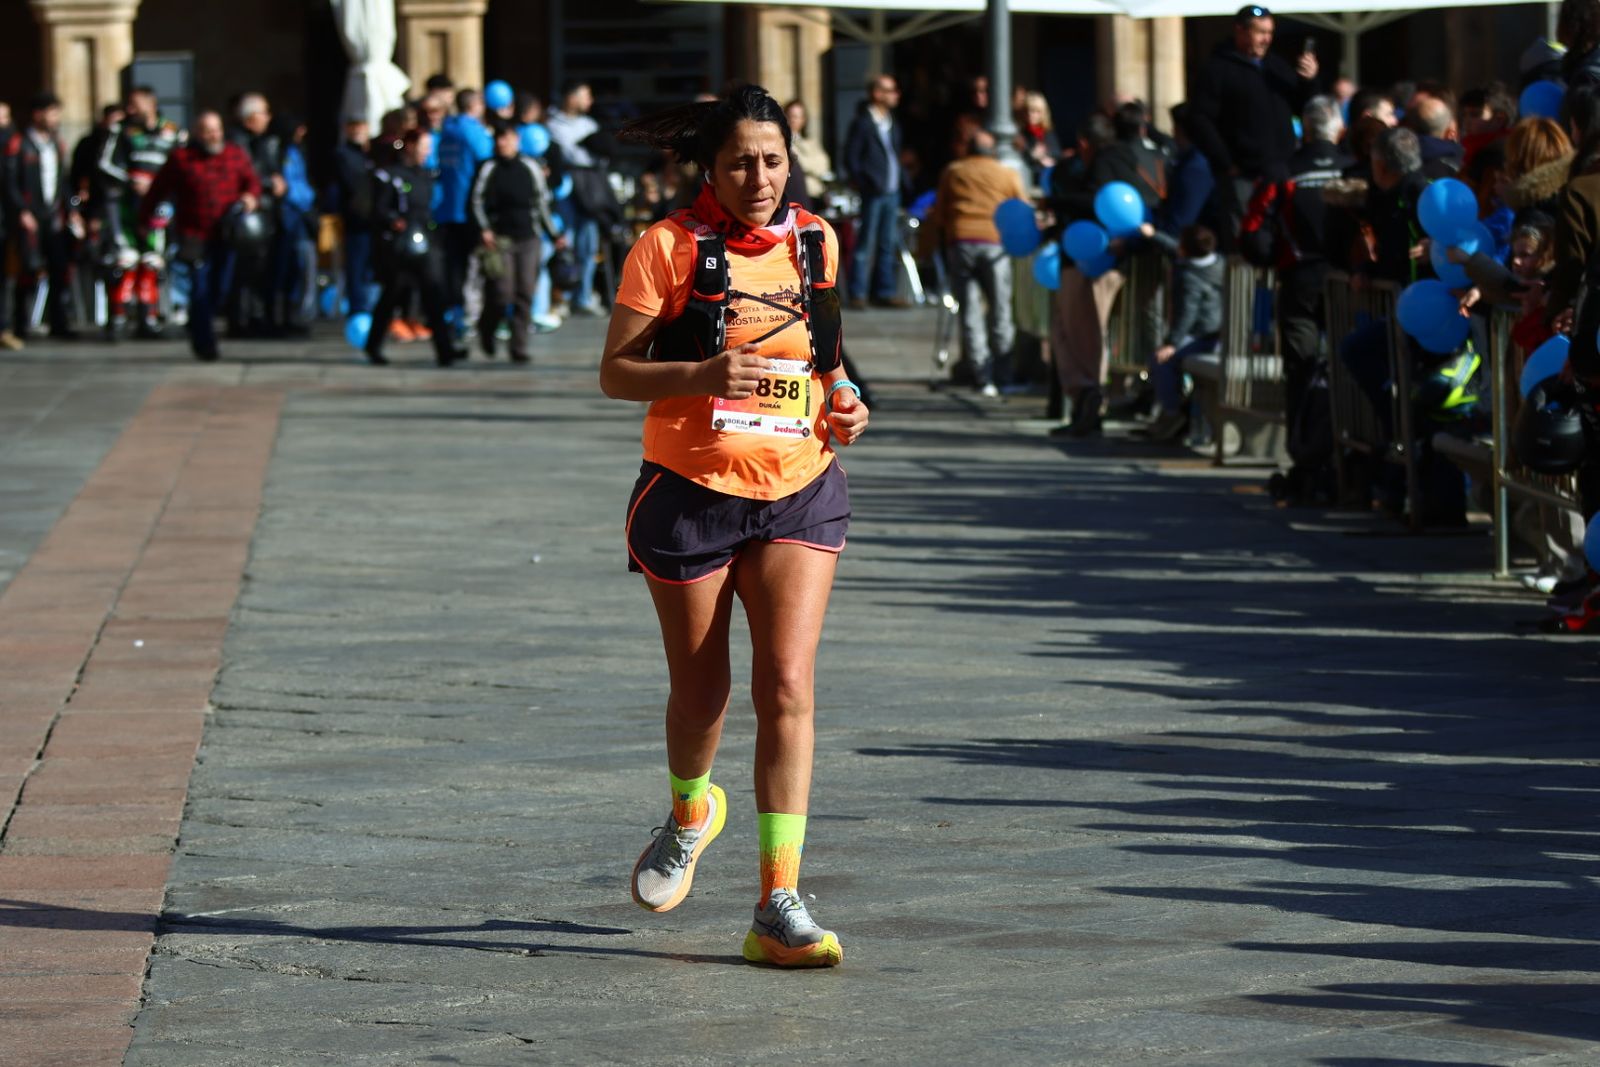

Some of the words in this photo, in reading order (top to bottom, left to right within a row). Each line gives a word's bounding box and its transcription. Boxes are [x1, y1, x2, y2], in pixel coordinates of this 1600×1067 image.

[727, 316, 762, 326] NOSTIA
[755, 378, 800, 400] 858
[758, 401, 782, 409] DURÁN
[724, 418, 748, 426] ABORAL
